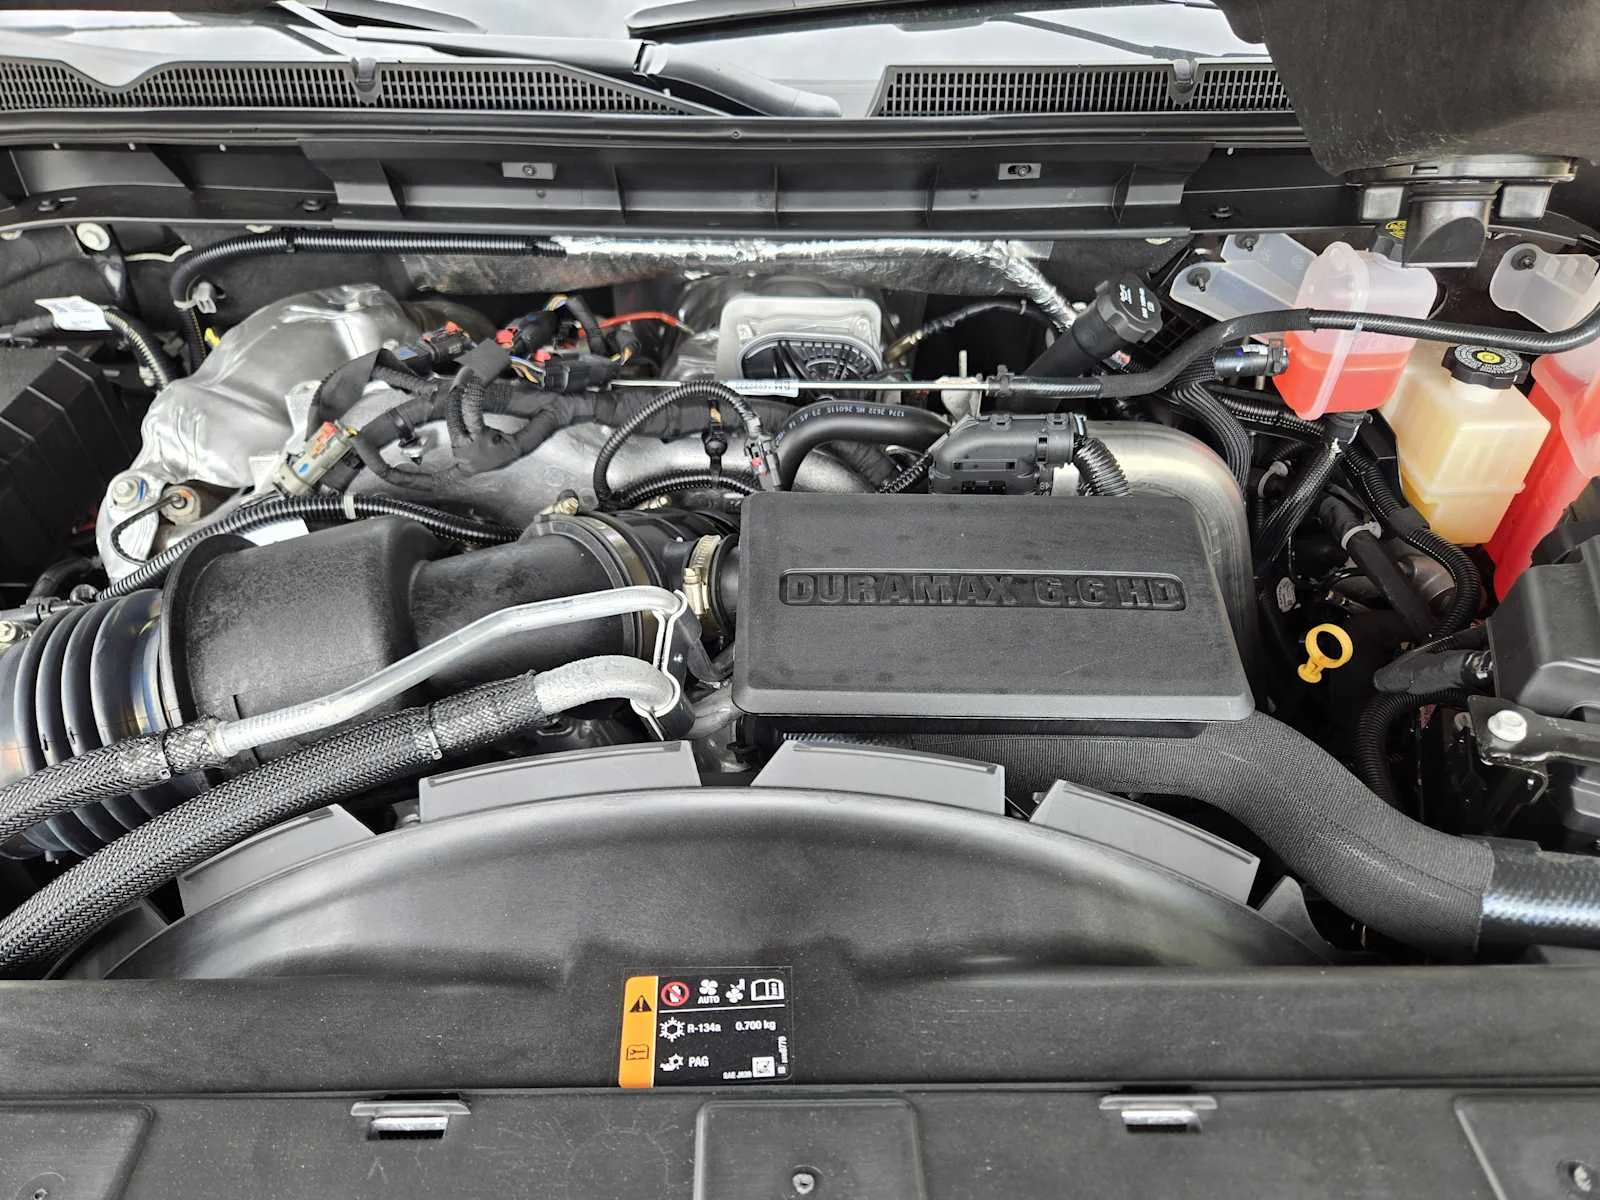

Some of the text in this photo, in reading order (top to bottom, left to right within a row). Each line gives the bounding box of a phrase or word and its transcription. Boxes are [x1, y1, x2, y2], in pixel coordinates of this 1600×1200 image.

[785, 573, 1183, 610] DURAMAX 6.6 HD
[697, 995, 720, 1004] AUTO
[687, 1020, 777, 1033] R-134a 0.700 kg
[688, 1055, 710, 1068] PAG
